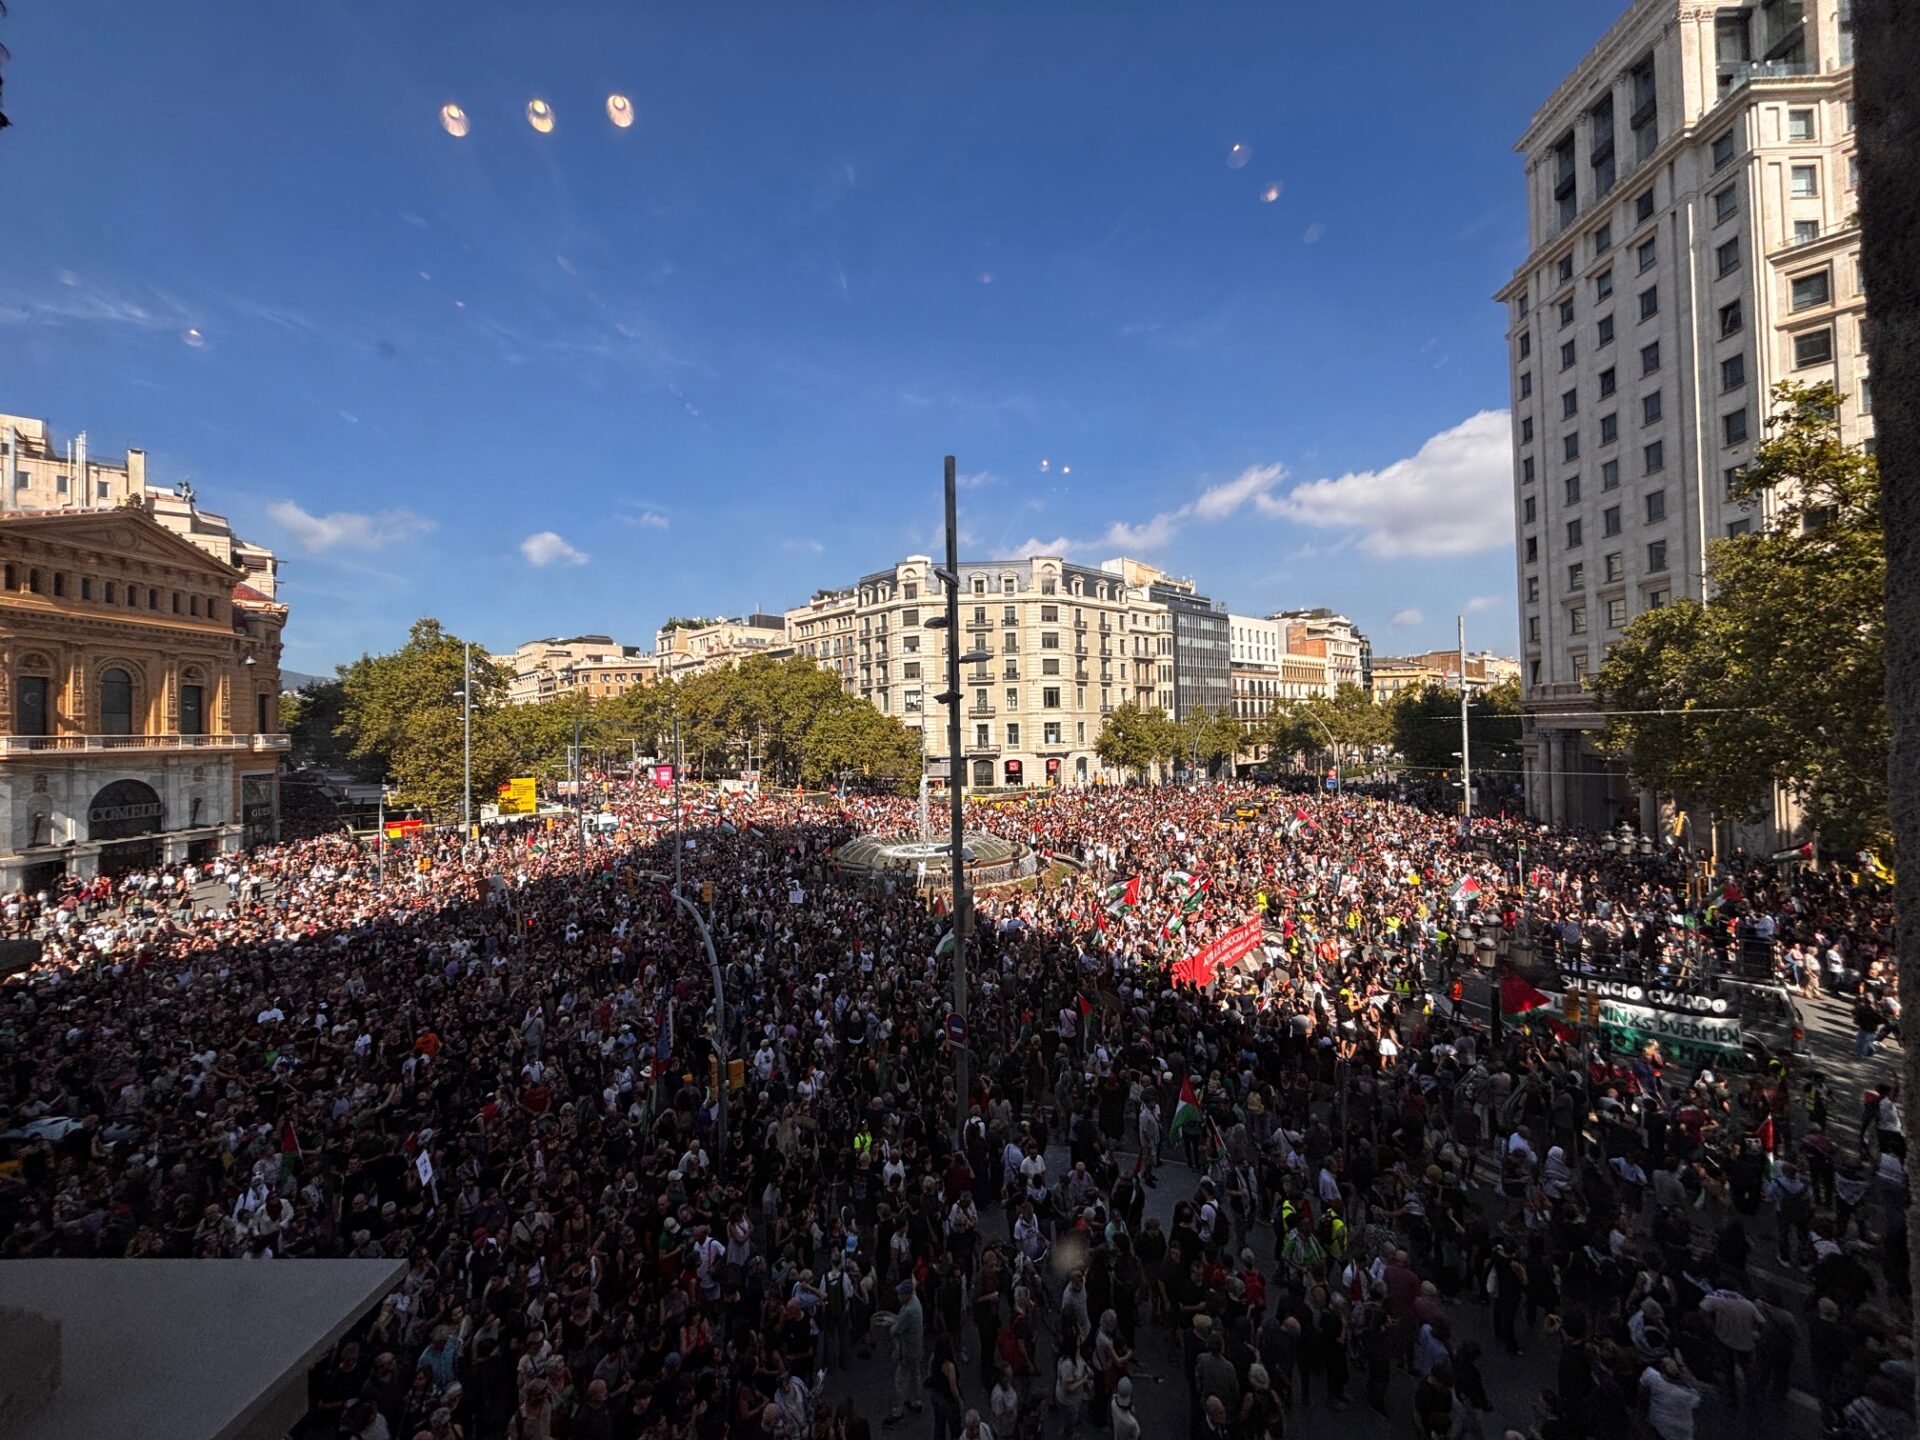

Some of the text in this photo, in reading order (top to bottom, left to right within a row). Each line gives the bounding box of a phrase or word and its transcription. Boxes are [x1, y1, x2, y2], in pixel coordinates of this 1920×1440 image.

[1553, 994, 1588, 1016] LS
[1560, 974, 1728, 1013] SILENCIO CUANDO
